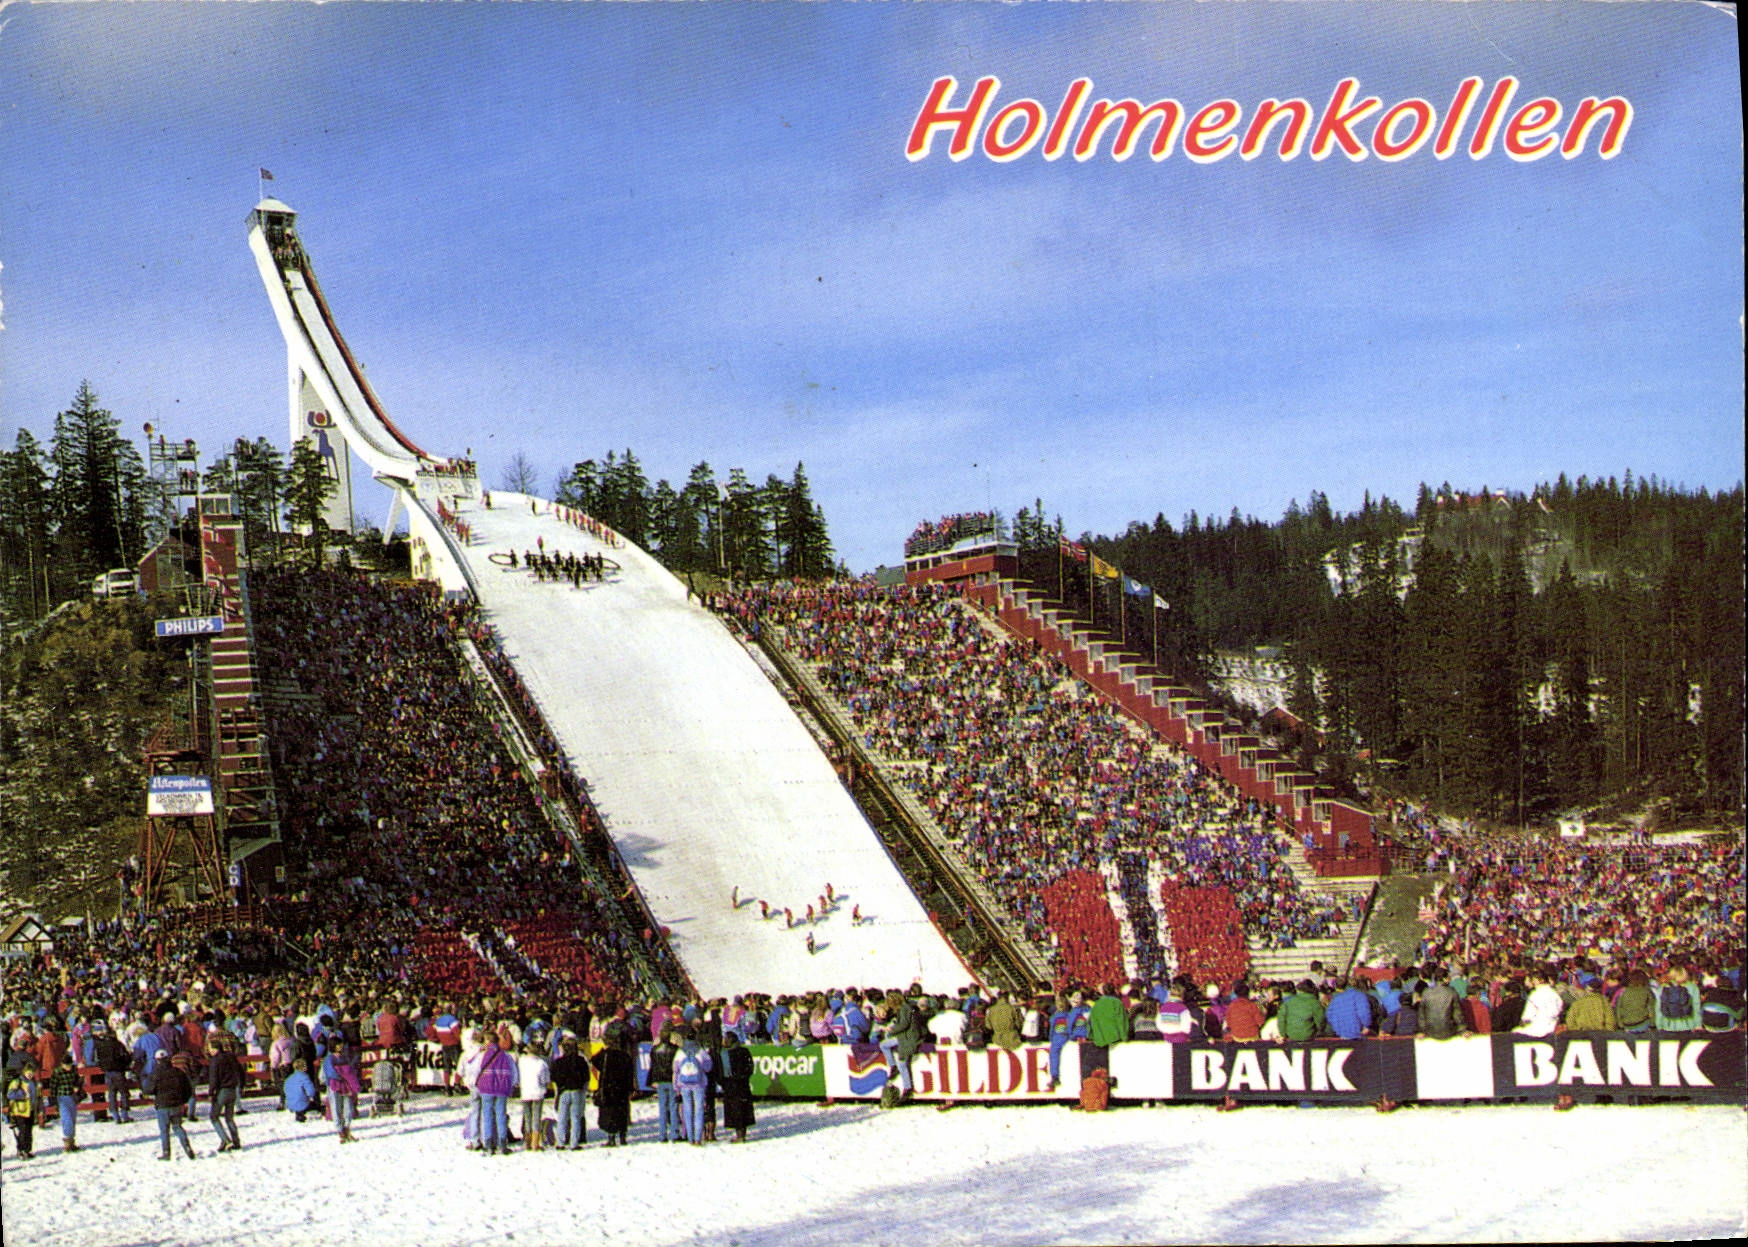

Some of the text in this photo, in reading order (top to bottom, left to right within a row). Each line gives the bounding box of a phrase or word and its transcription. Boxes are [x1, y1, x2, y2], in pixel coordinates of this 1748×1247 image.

[164, 617, 214, 635] PHILIPS
[911, 1047, 1056, 1095] GILDE
[1190, 1048, 1357, 1092] BANK
[1514, 1040, 1715, 1088] BANK
